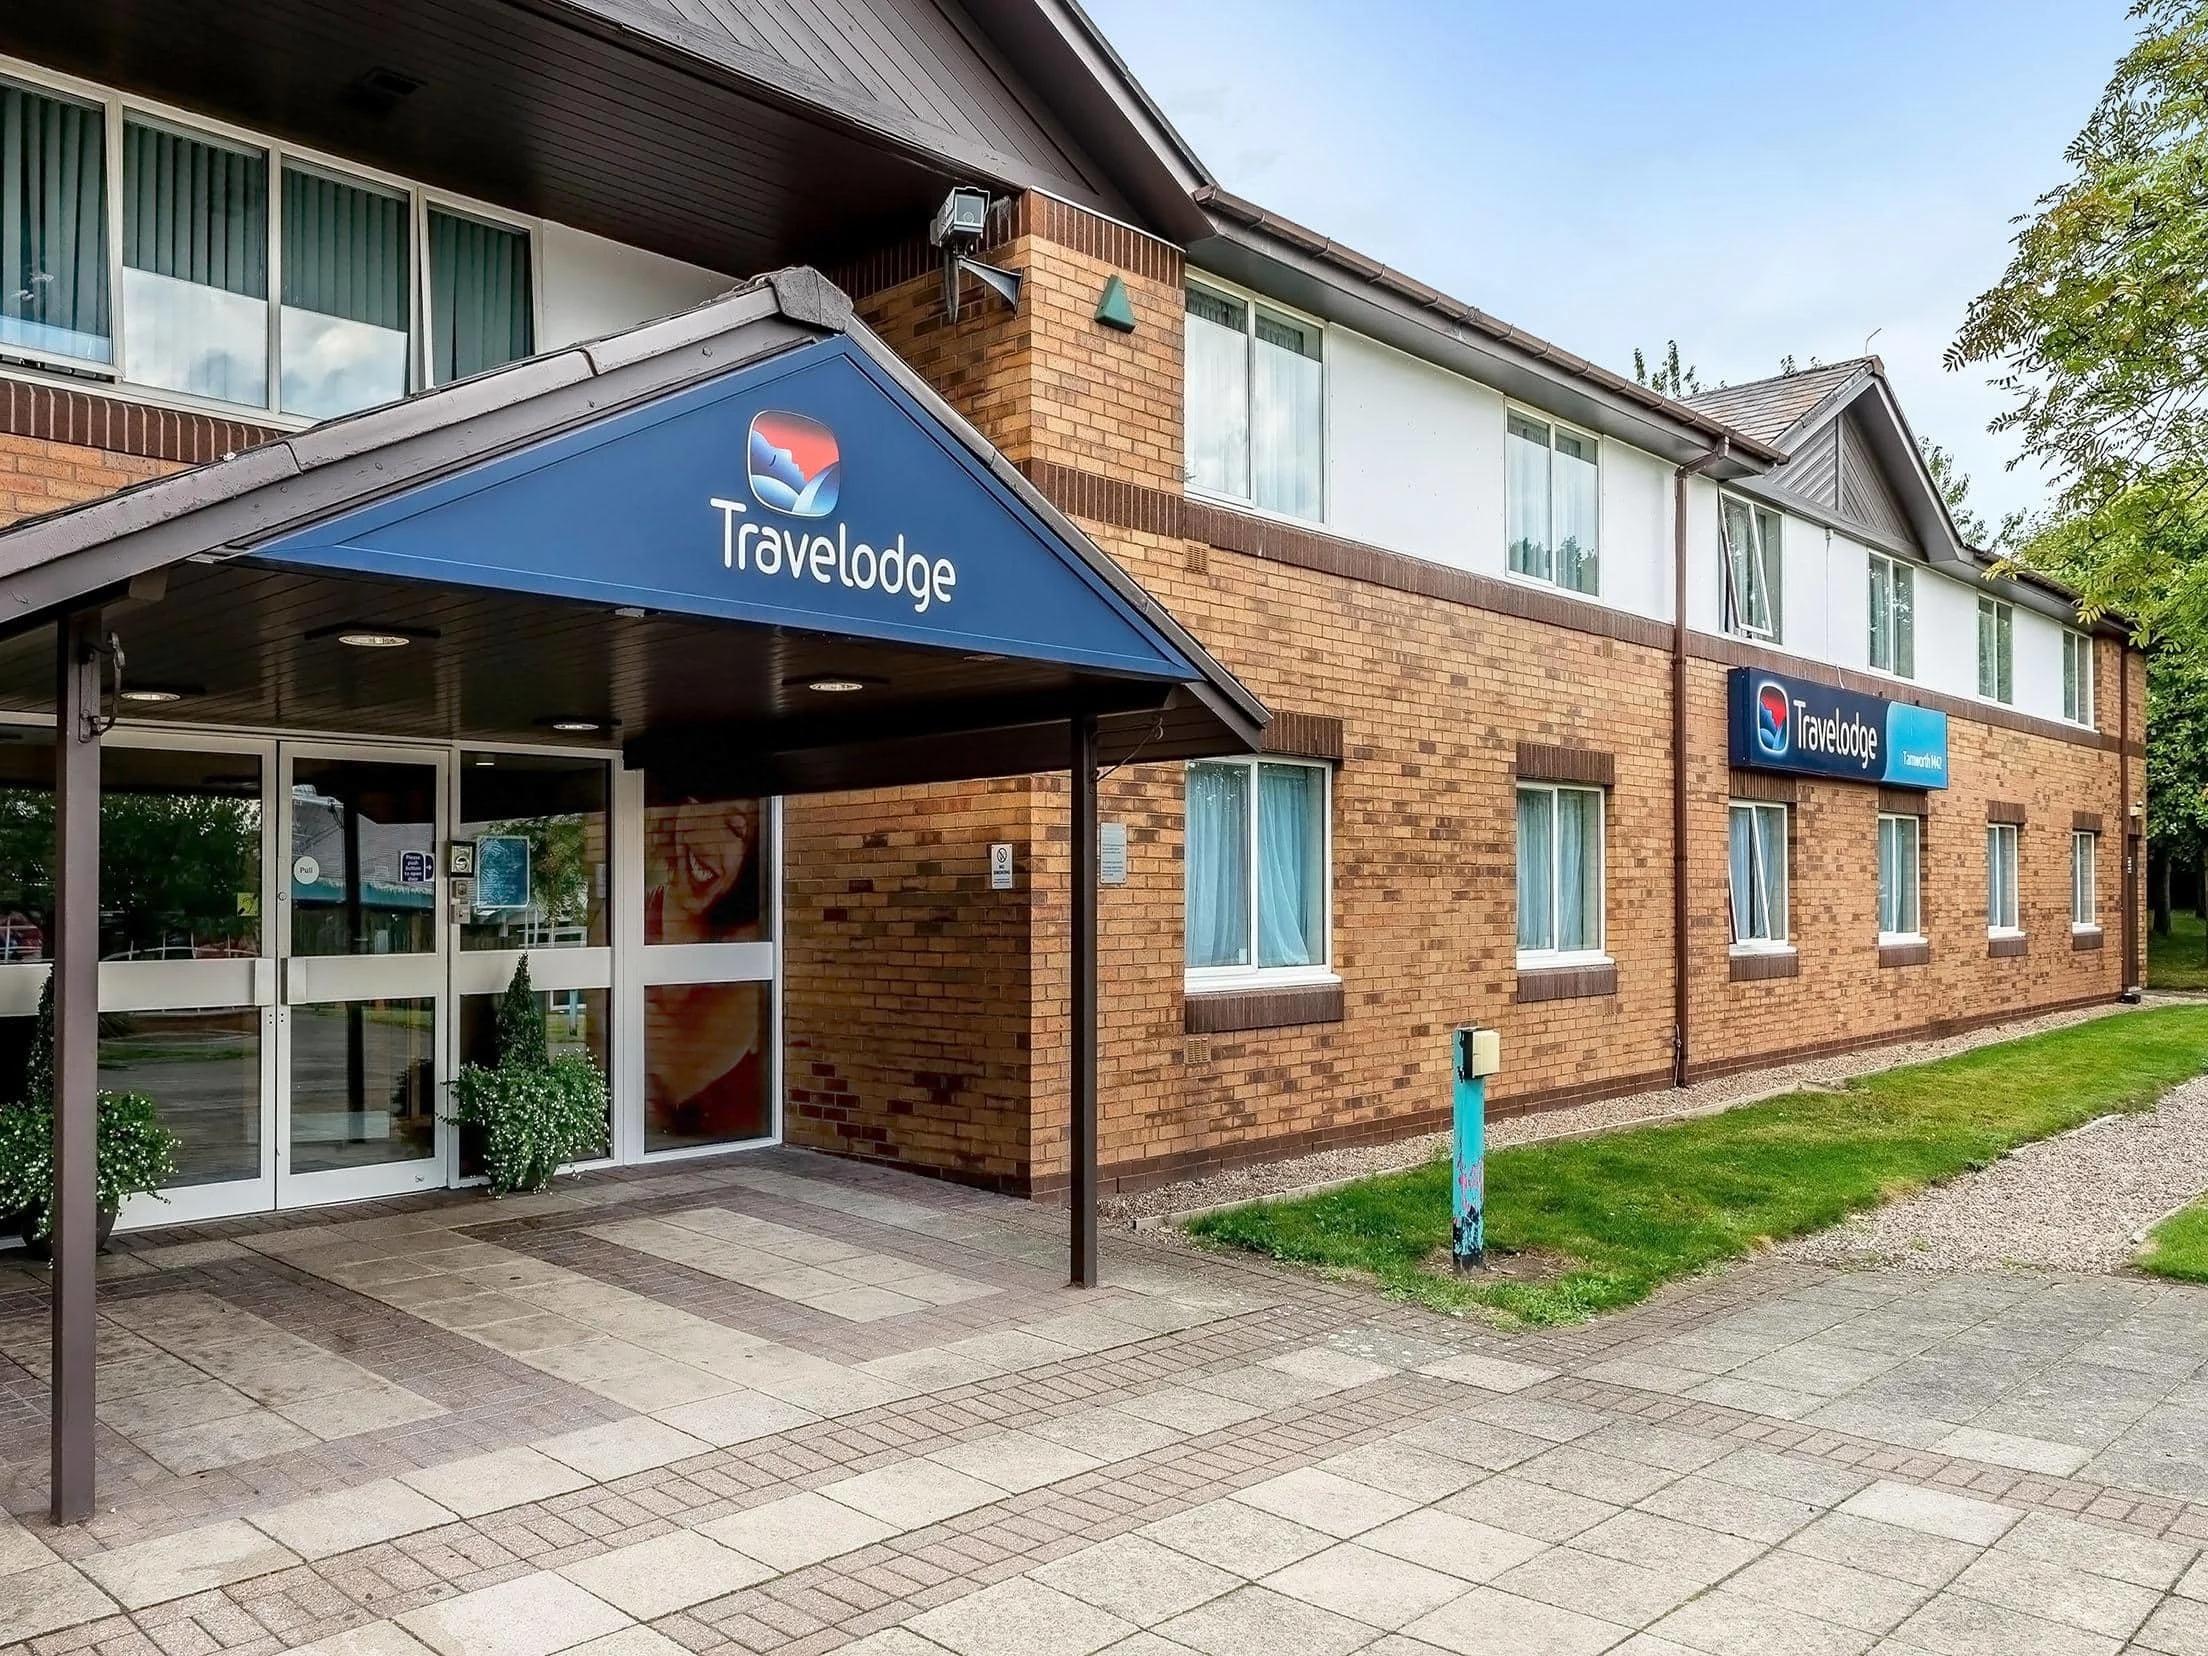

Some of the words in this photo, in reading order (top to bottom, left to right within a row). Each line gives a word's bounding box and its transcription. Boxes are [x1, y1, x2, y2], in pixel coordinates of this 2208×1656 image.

[711, 498, 957, 613] Travelodge
[1793, 699, 1877, 769] Travelodge
[1902, 750, 1930, 768] Tamworth
